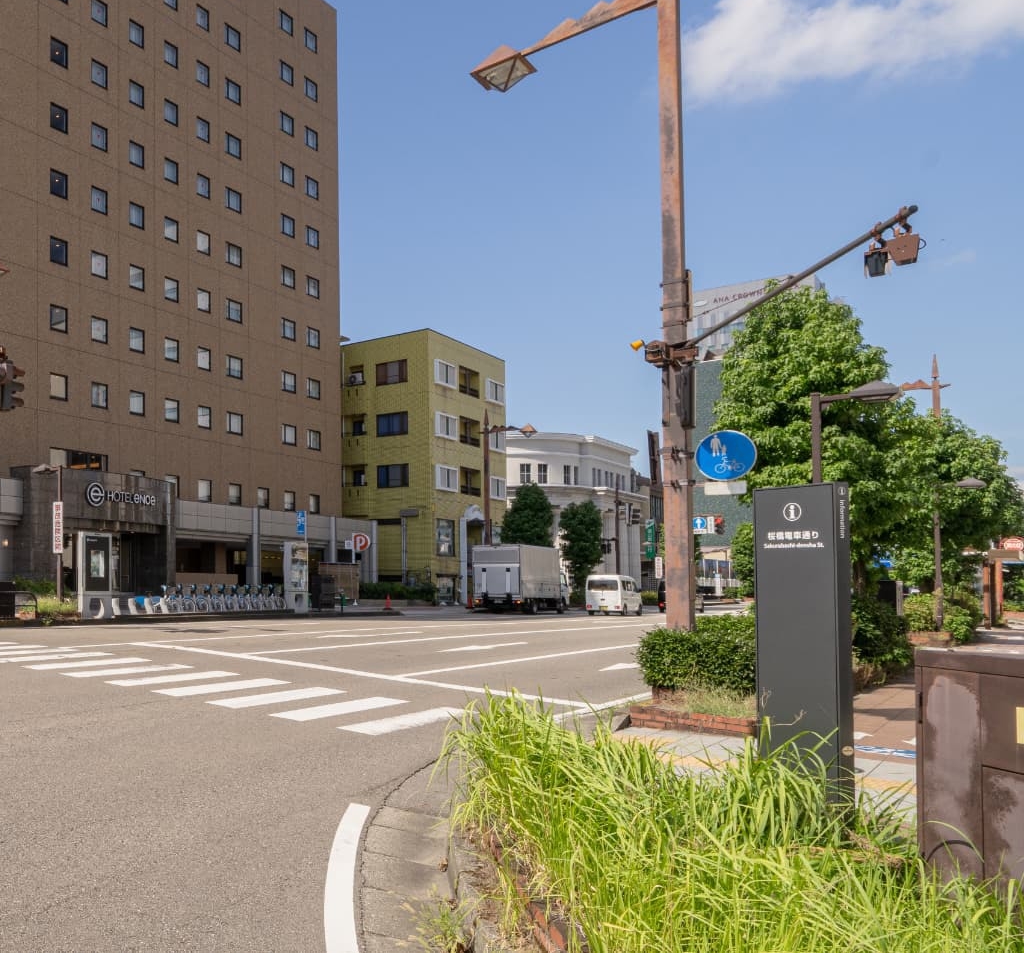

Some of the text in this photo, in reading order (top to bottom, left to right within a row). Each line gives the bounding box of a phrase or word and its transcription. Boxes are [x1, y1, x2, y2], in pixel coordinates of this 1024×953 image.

[713, 287, 765, 304] ANA CROWN
[107, 490, 133, 504] HOTEL
[767, 530, 819, 541] 桜橋電車通り
[763, 541, 825, 550] Sakurabashi-densha St.
